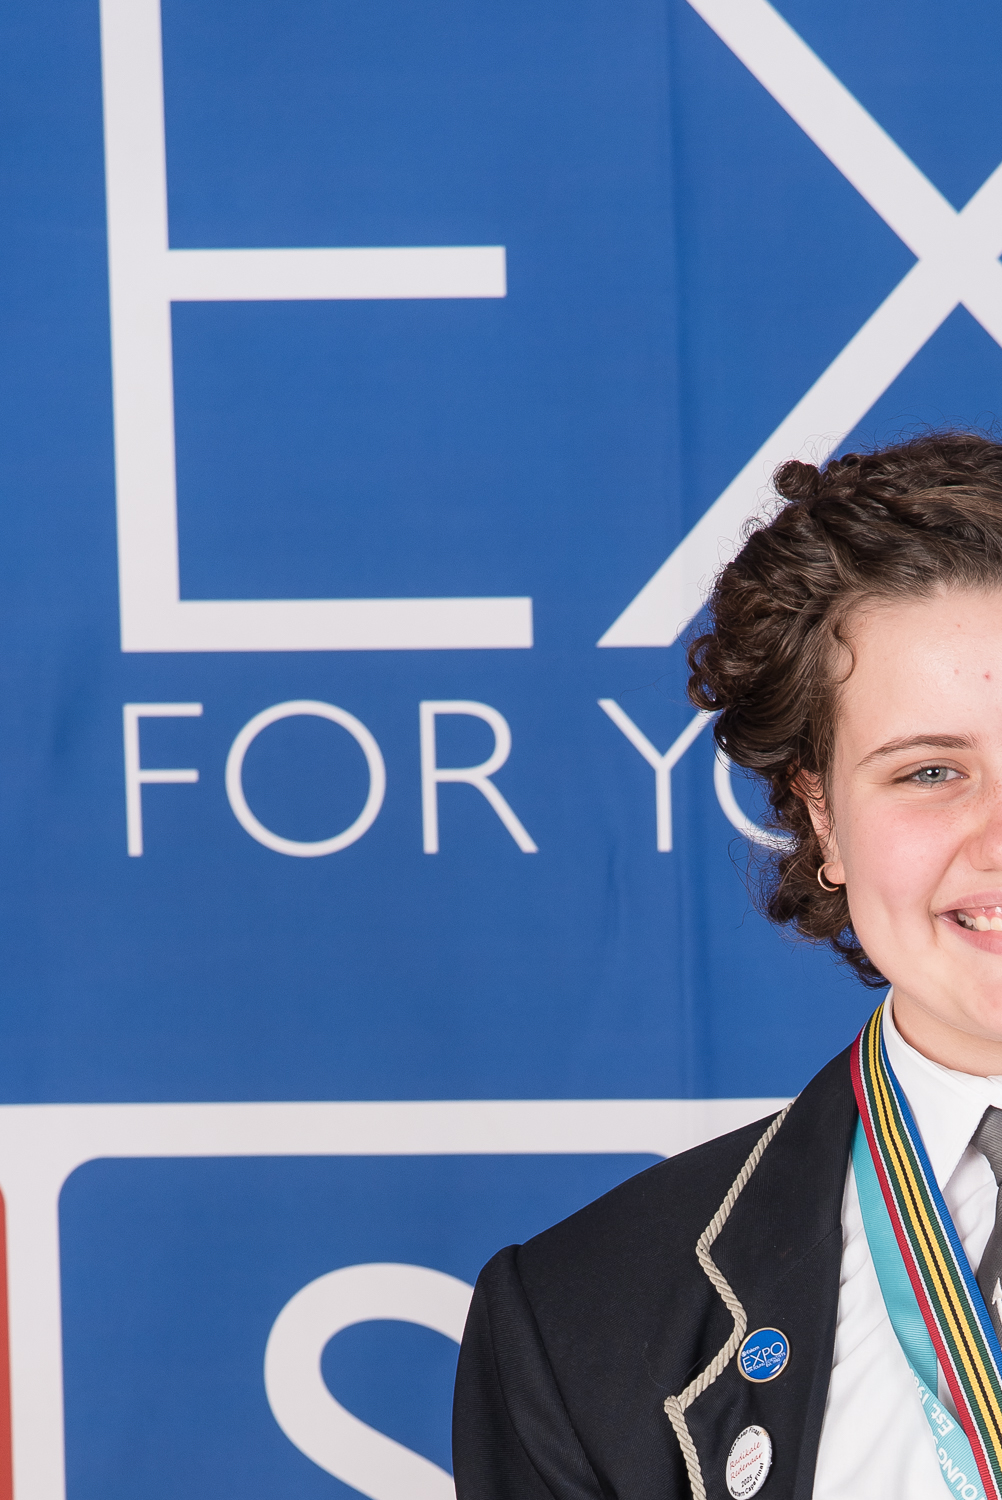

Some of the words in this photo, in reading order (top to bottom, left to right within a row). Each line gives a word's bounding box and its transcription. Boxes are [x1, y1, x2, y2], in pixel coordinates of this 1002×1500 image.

[122, 699, 538, 858] FOR
[742, 1341, 784, 1371] EXPO
[931, 1403, 954, 1437] Est.
